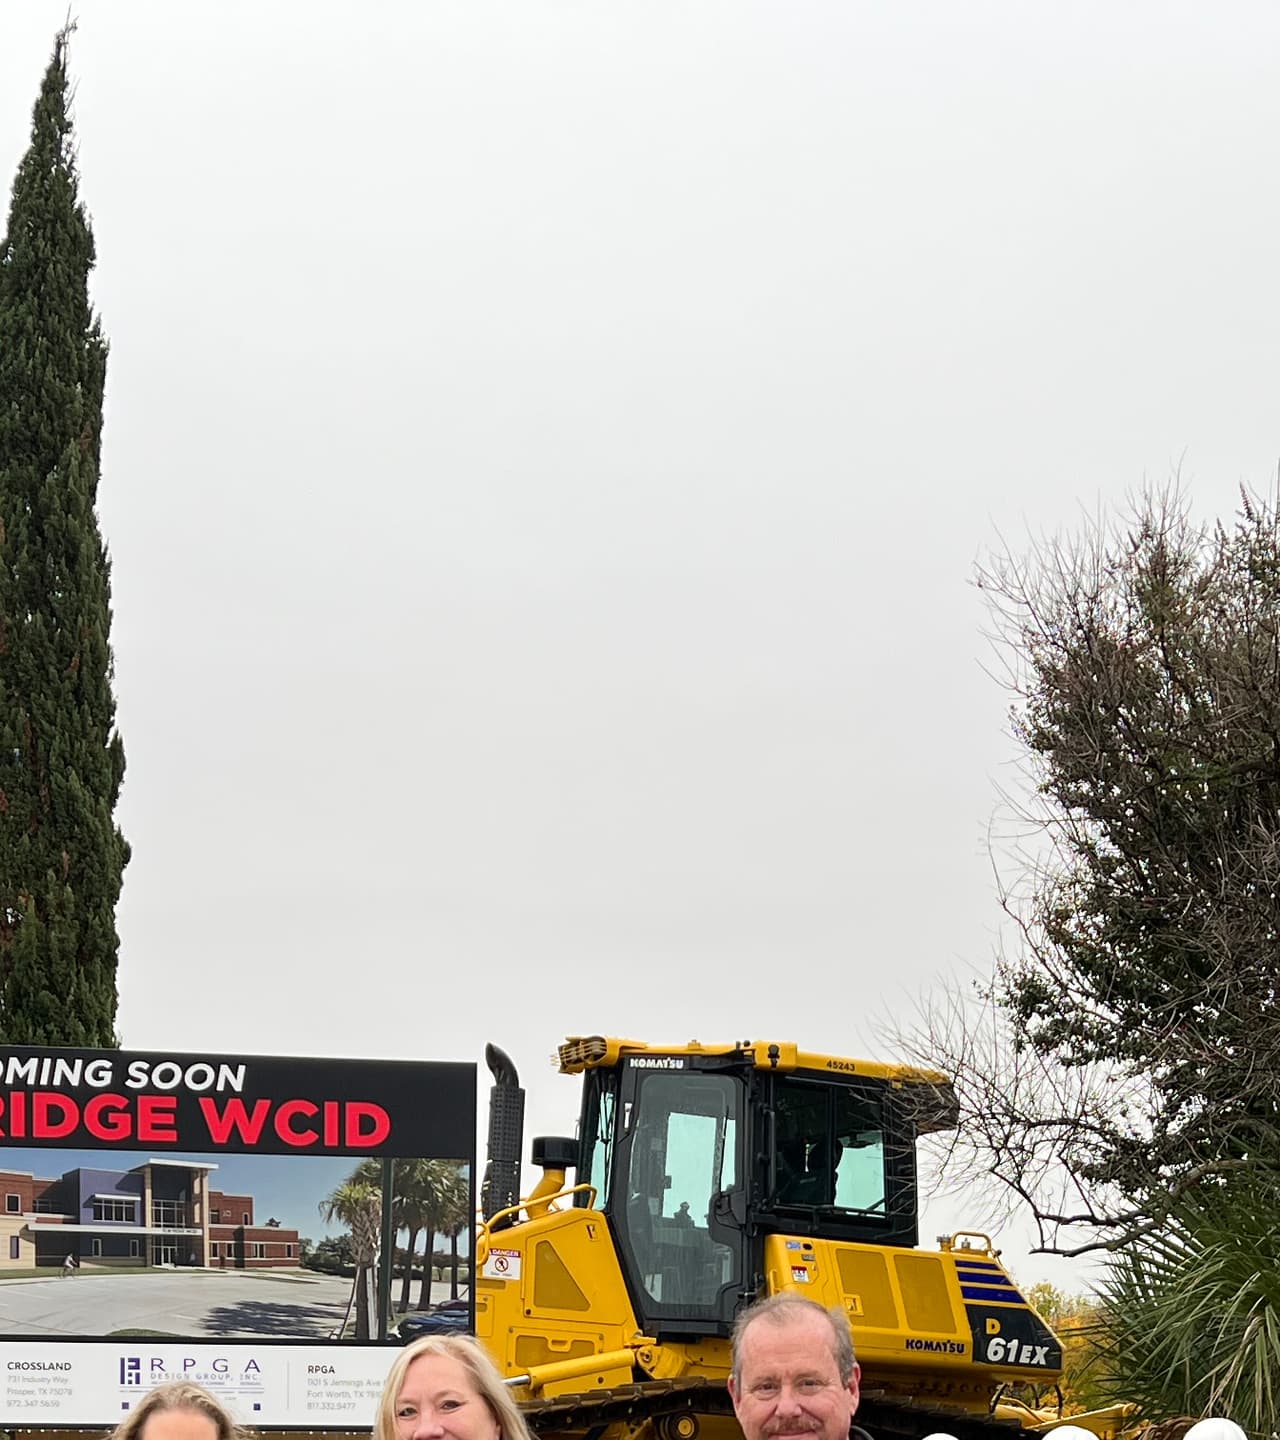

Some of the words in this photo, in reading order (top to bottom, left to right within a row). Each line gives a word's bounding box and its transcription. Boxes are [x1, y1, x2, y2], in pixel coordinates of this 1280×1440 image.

[630, 1057, 684, 1069] KOMATSU
[826, 1060, 856, 1072] 45243
[124, 1060, 246, 1092] SOON
[198, 1096, 391, 1148] WCID
[985, 1318, 1001, 1335] D
[905, 1339, 965, 1354] KOMATSU
[987, 1337, 1050, 1365] 61EX
[6, 1361, 72, 1371] CROSSLAND
[307, 1365, 336, 1374] RPGA
[150, 1372, 190, 1380] DESIGN
